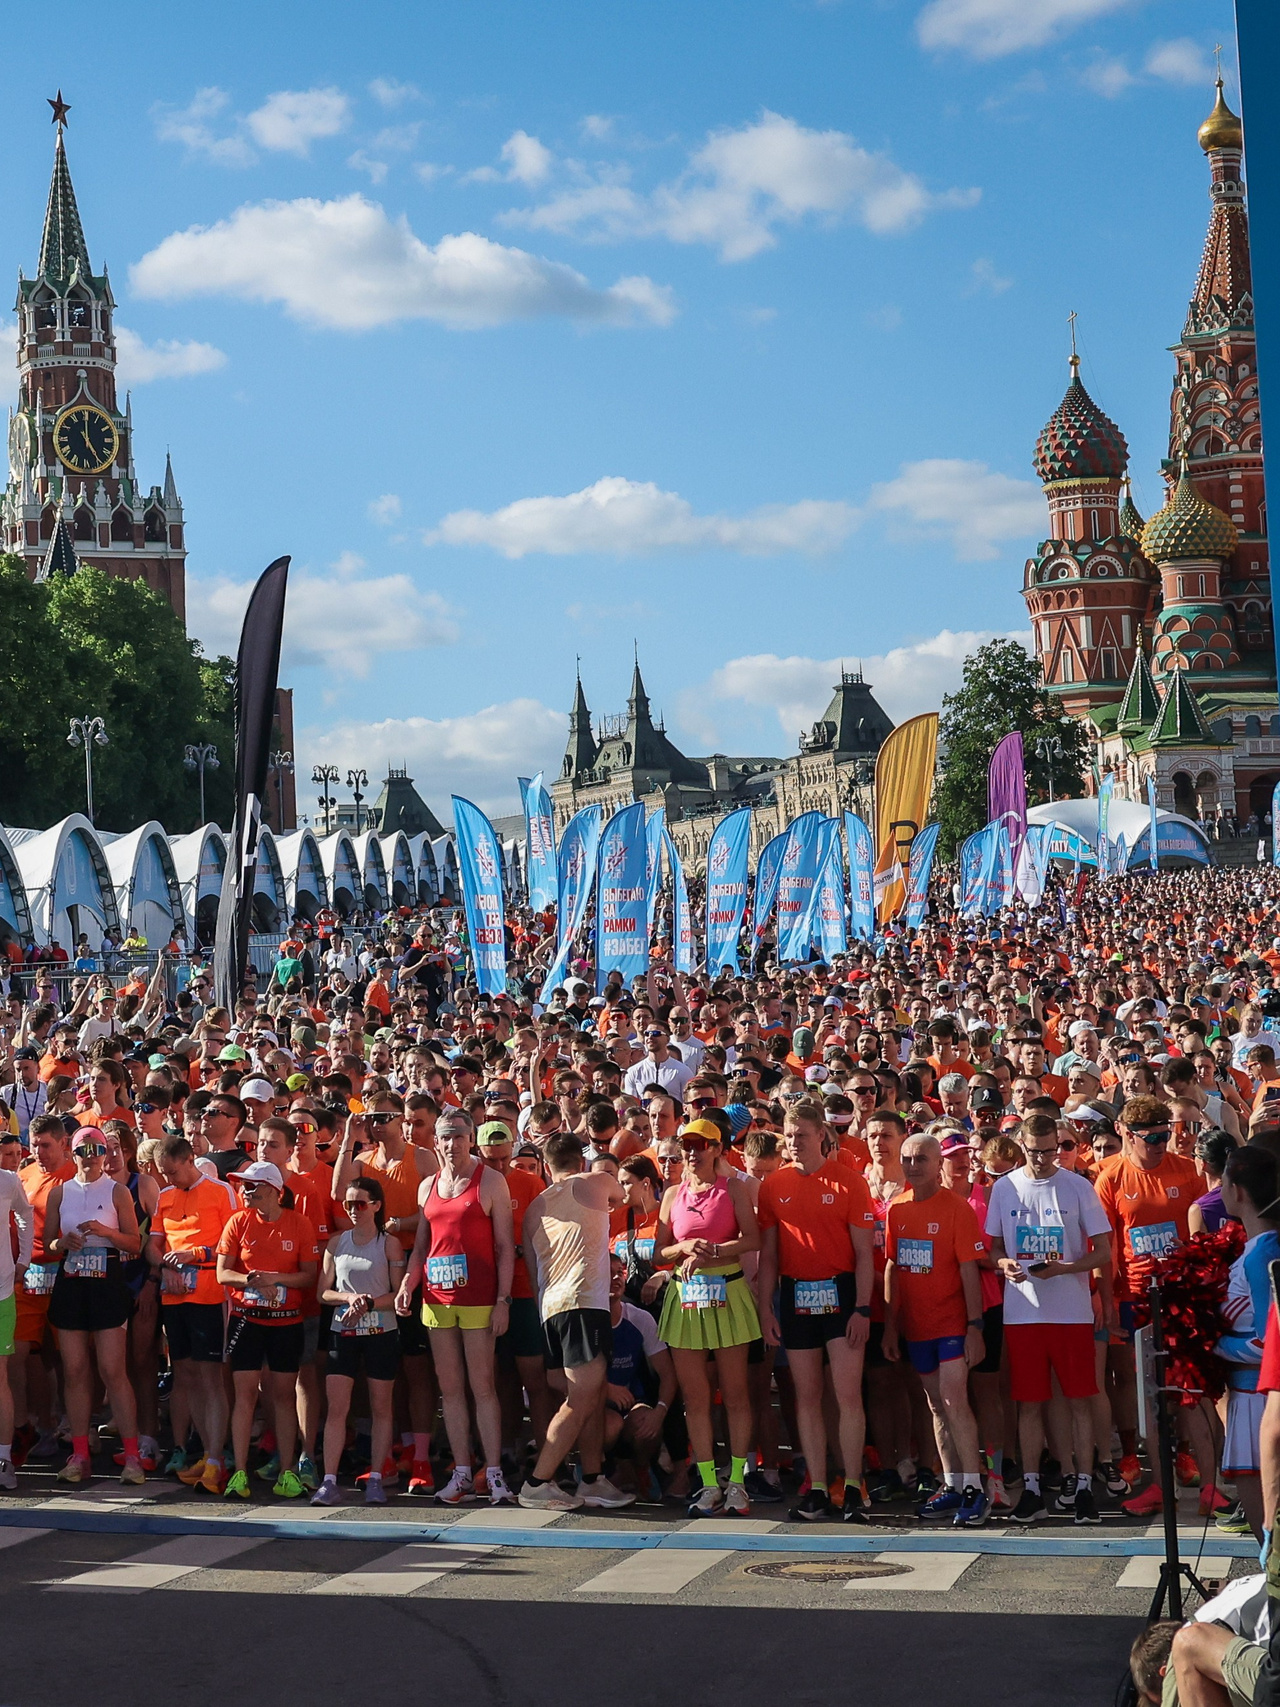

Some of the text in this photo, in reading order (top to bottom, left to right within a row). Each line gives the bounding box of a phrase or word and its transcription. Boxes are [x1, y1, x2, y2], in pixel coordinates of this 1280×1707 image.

[604, 887, 644, 902] ВЫБЕГАЮ
[604, 904, 616, 918] ЗА
[604, 918, 635, 933] РАМКИ
[822, 1193, 834, 1205] 10
[927, 1222, 939, 1235] 10
[281, 1239, 293, 1252] 10
[1022, 1235, 1058, 1252] 42113
[431, 1264, 463, 1283] 37315
[685, 1284, 721, 1301] 32217
[796, 1289, 836, 1307] 32205
